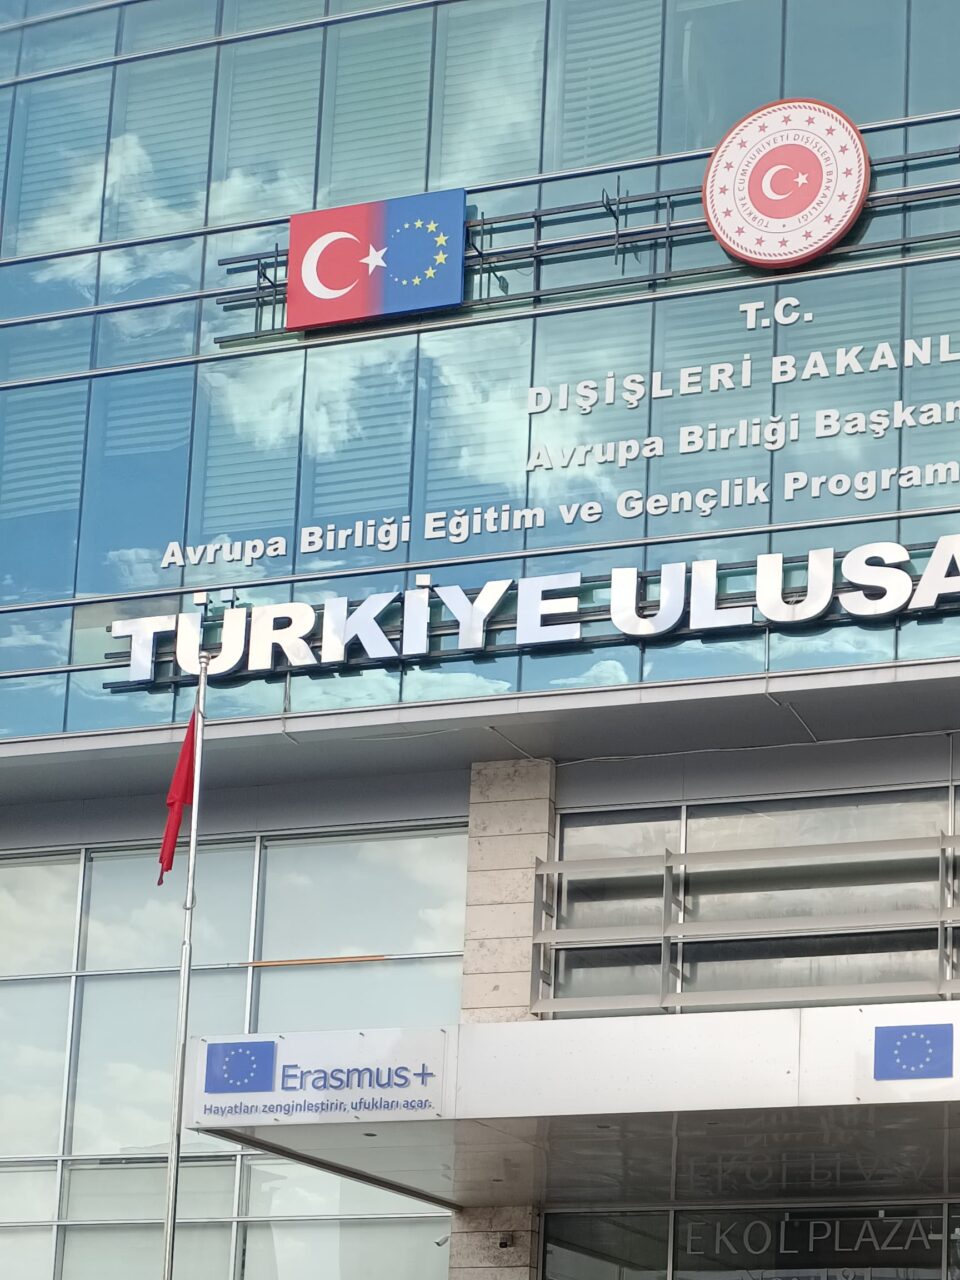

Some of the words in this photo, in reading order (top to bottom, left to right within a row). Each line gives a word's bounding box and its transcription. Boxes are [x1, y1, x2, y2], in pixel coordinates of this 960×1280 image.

[739, 297, 813, 330] T.C.
[527, 353, 752, 415] DIŞİŞLERİ
[526, 435, 664, 472] Avrupa
[679, 413, 800, 454] Birliği
[160, 535, 287, 568] Avrupa
[300, 515, 412, 554] Birliği
[424, 504, 546, 544] Eğitim
[558, 500, 604, 524] ve
[616, 476, 770, 517] Gençlik
[111, 572, 582, 684] TÜRKİYE
[280, 1063, 437, 1092] Erasmus+
[203, 1101, 259, 1117] Hayatları
[350, 1097, 399, 1112] ufukları
[686, 1220, 799, 1254] EKOL
[808, 1218, 931, 1252] PLAZA
